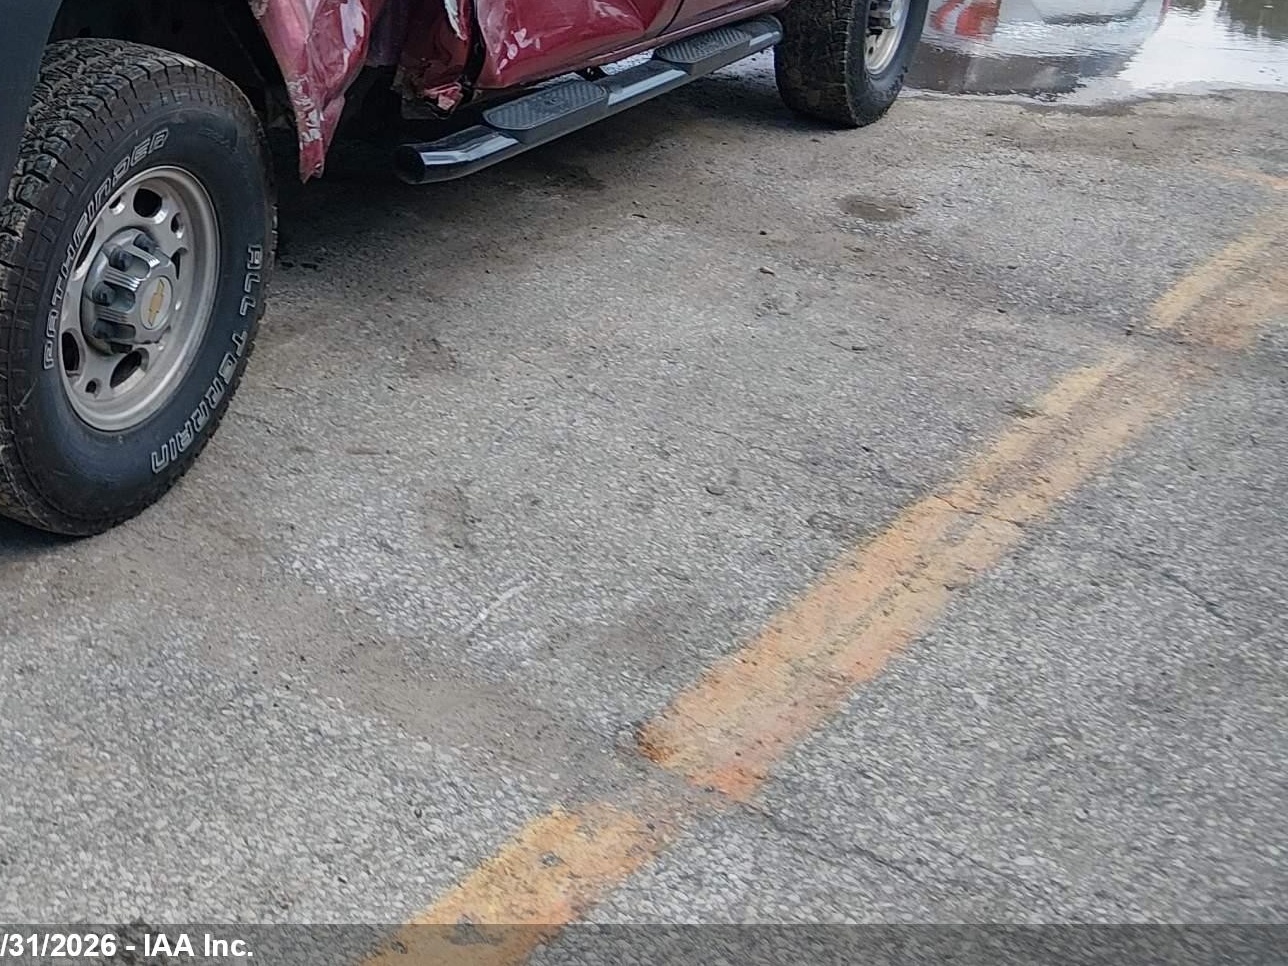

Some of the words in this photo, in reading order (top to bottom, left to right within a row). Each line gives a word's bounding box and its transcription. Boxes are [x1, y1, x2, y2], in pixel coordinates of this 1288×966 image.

[43, 129, 168, 370] PATHFINDER
[239, 243, 263, 316] ALL
[151, 331, 249, 474] TERRAIN
